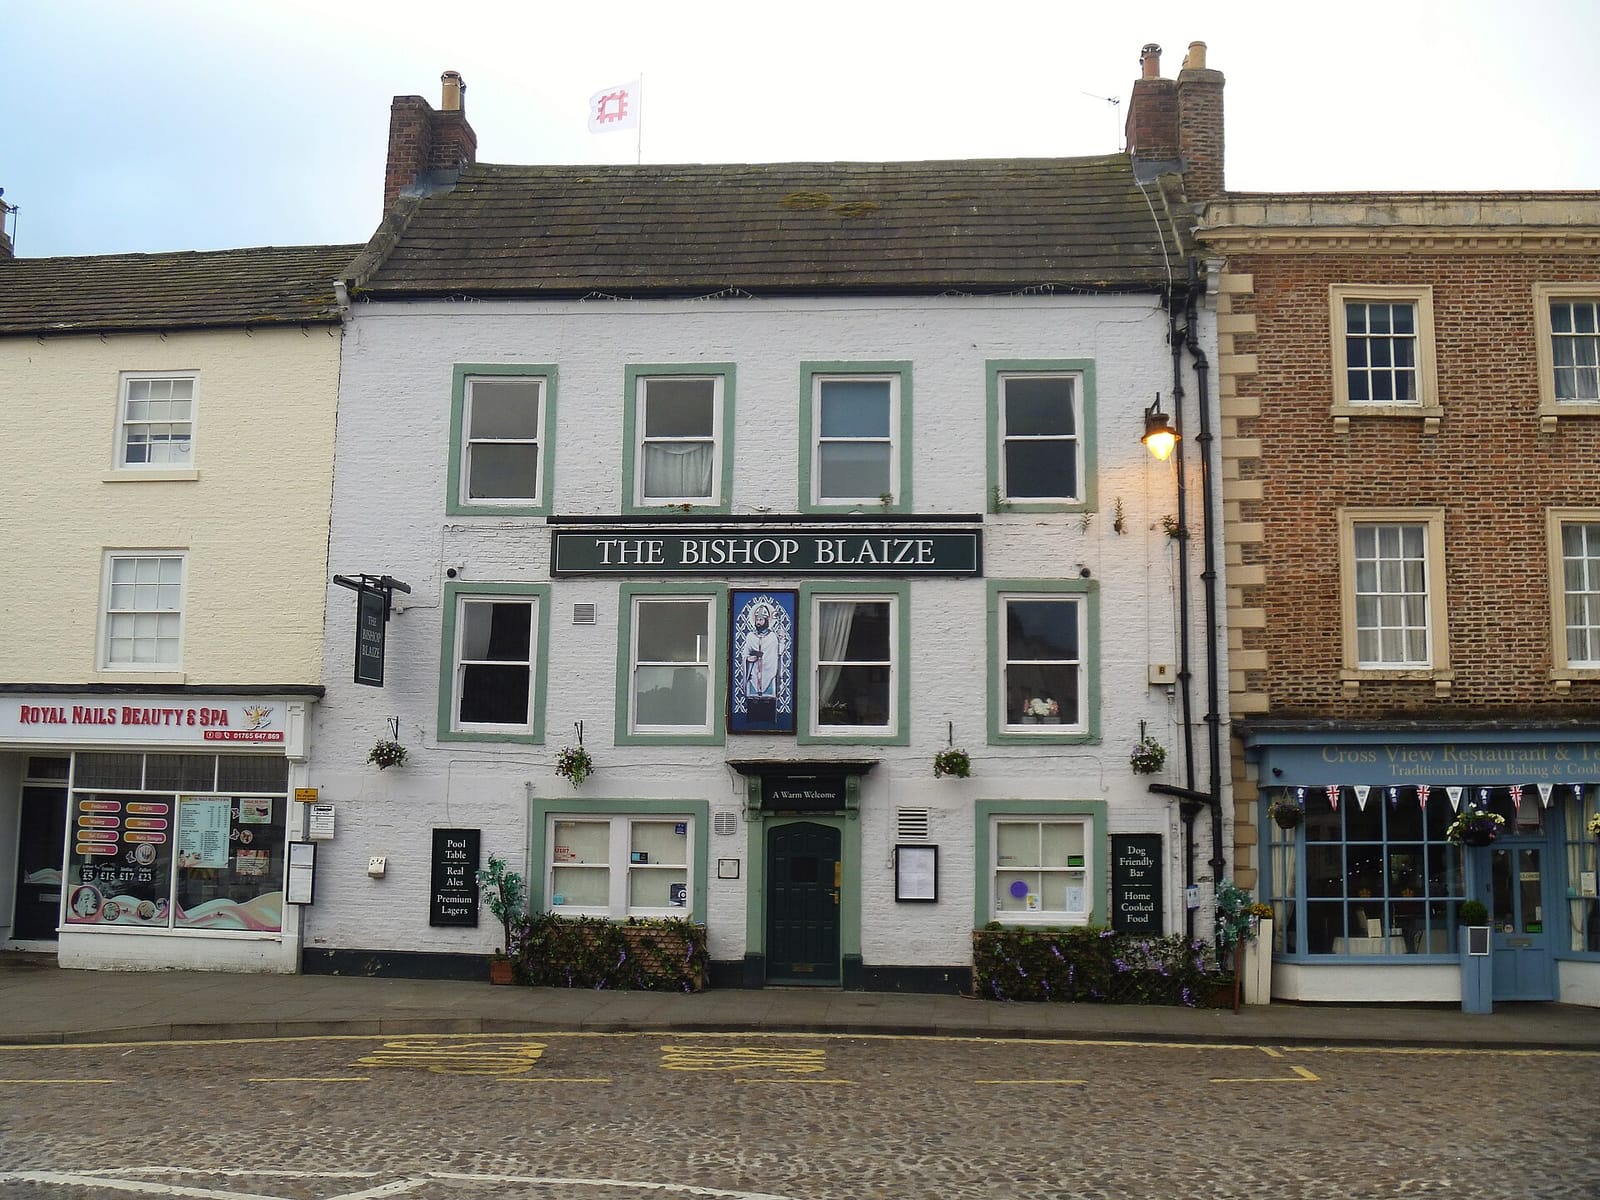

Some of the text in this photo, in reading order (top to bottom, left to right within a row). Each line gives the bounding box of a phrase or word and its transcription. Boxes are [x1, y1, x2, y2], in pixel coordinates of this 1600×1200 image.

[595, 538, 935, 565] THE BISHOP BLAIZE
[368, 615, 377, 627] THE
[362, 628, 381, 643] BISHOP
[362, 644, 380, 659] BLAIZE
[20, 705, 229, 727] ROYAL NAILS BEAUTY & SPA
[1321, 744, 1377, 763] Cross
[1384, 744, 1434, 763] View
[1443, 744, 1549, 762] Restaurant
[1554, 743, 1571, 761] &
[1388, 763, 1458, 777] Traditional
[1463, 763, 1501, 777] Home
[1506, 763, 1549, 778] Baking
[1552, 763, 1562, 776] &
[772, 790, 836, 799] A Warm Welcome
[447, 839, 466, 848] Pool
[445, 850, 467, 859] Table
[1127, 846, 1146, 856] Dog
[1119, 857, 1154, 868] Friendly
[447, 866, 464, 875] Real
[1130, 868, 1145, 877] Bar
[100, 872, 116, 881] £15
[119, 872, 135, 881] £17
[446, 877, 464, 886] Ales
[437, 894, 472, 904] Premium
[1124, 891, 1151, 900] Home
[441, 905, 468, 916] Lagers
[1121, 902, 1154, 912] Cooked
[1127, 913, 1149, 923] Food
